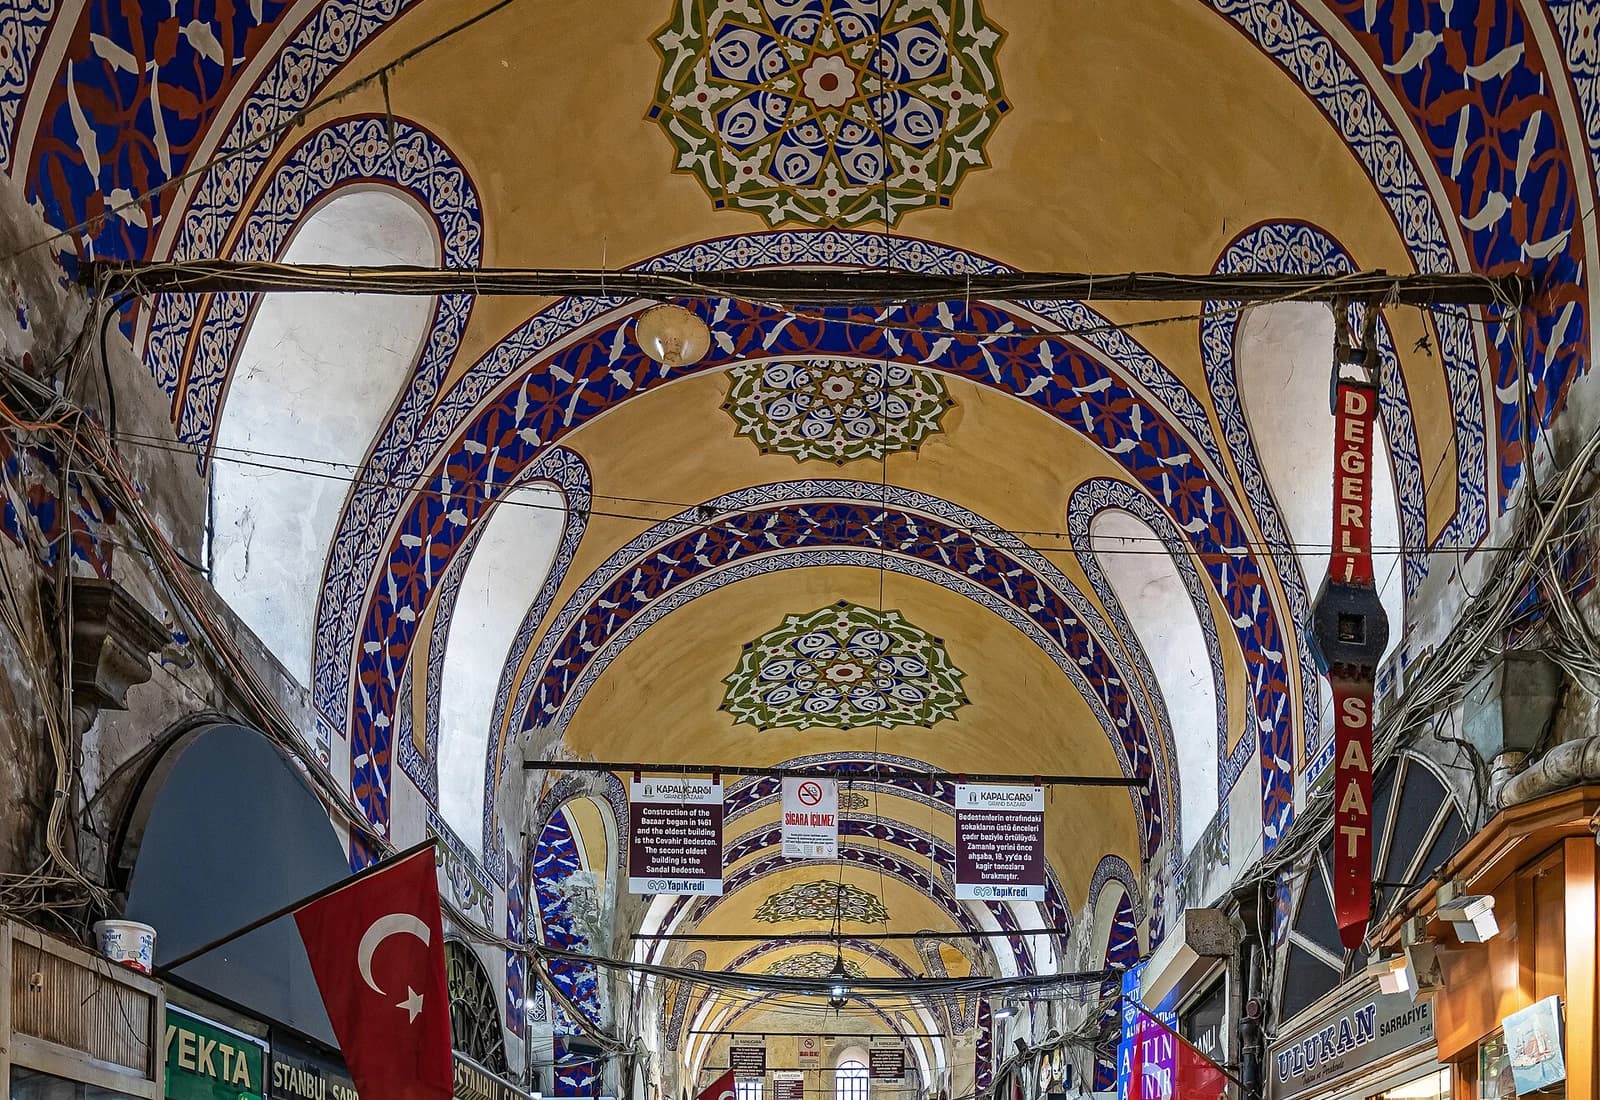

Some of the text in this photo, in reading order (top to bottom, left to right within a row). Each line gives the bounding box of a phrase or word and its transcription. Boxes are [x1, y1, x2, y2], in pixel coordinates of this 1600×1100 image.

[1339, 697, 1369, 859] SAAT
[643, 808, 688, 816] Construction
[689, 808, 697, 816] of
[666, 818, 688, 827] began
[689, 818, 697, 826] in
[785, 811, 835, 828] SİGARA İÇİLMEZ
[996, 823, 1011, 832] üstü
[1012, 824, 1039, 832] önceleri
[687, 828, 716, 837] building
[634, 836, 642, 844] is
[642, 836, 654, 844] the
[645, 846, 707, 855] The second oldest
[996, 843, 1015, 853] yerini
[1016, 843, 1033, 851] önce
[651, 856, 701, 865] building is the
[1277, 1002, 1428, 1084] ULUKAN SARRAFİYE
[164, 1024, 251, 1089] YEKTA
[1120, 1033, 1173, 1077] ATIN
